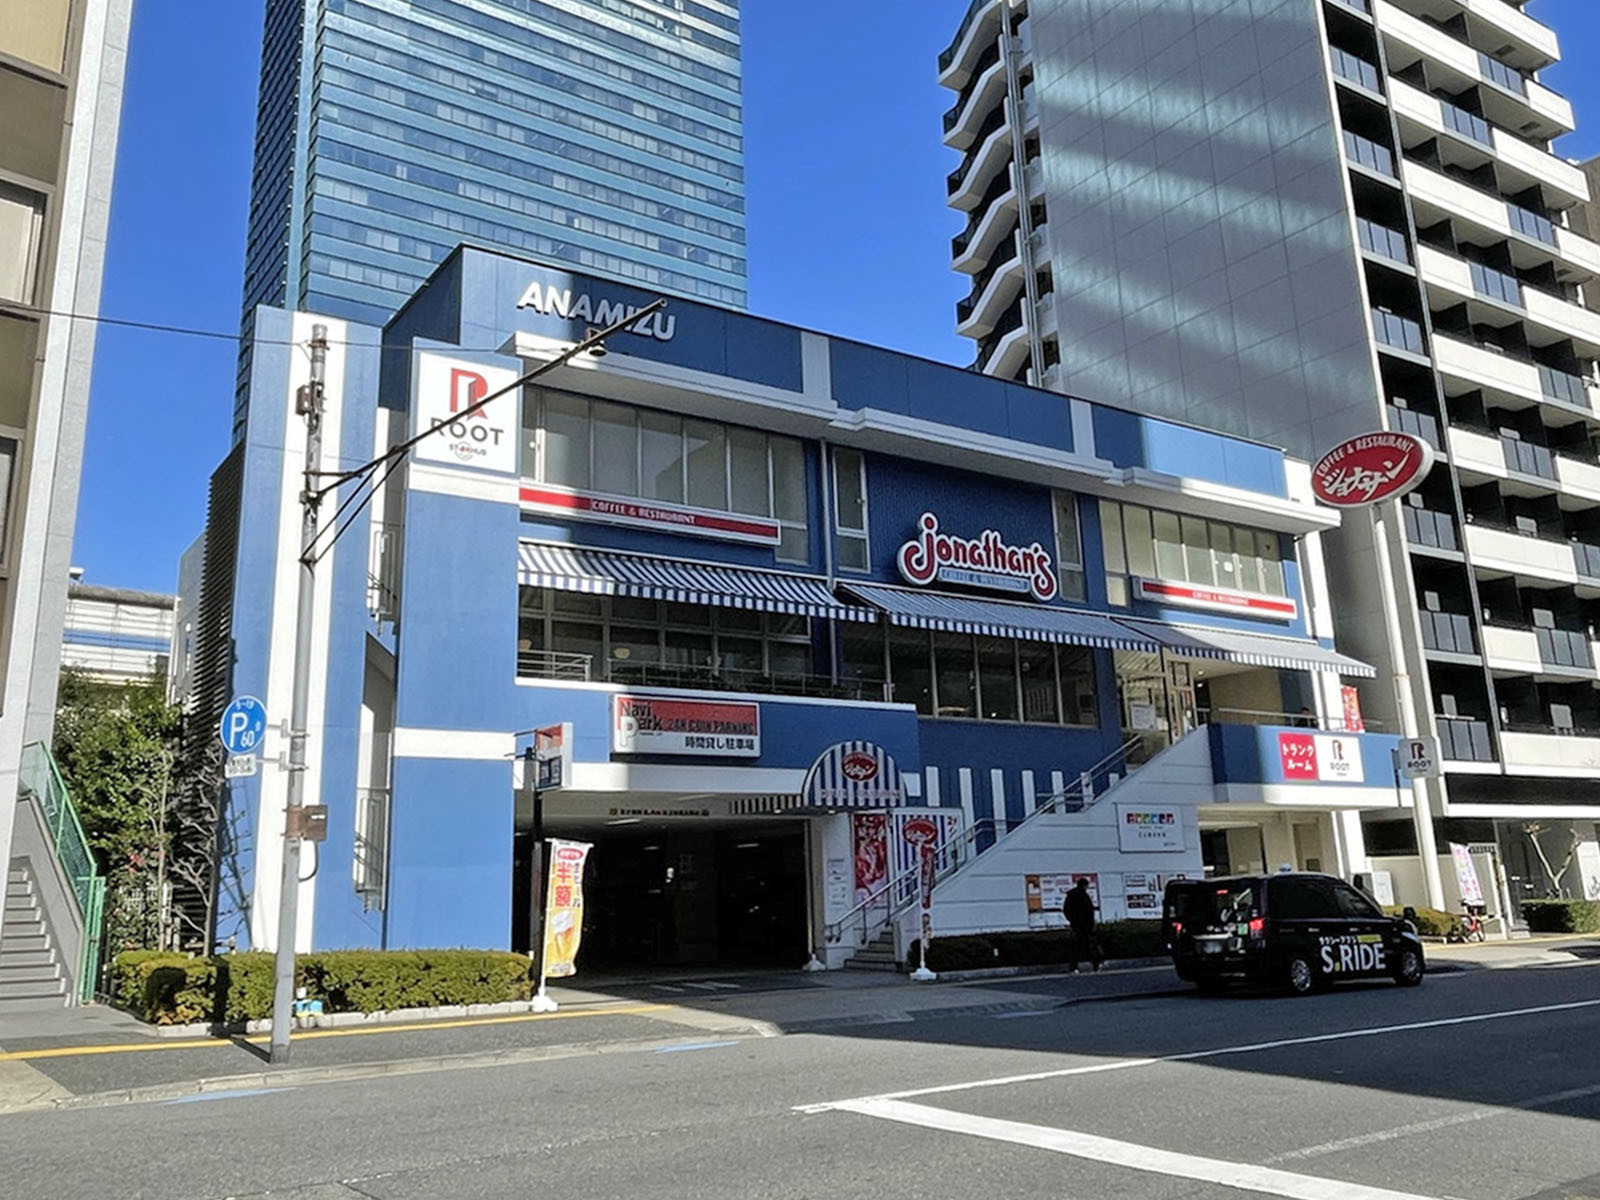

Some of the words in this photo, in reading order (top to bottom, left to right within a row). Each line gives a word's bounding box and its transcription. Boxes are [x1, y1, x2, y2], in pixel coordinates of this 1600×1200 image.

[516, 281, 675, 341] ANAMIZU
[430, 417, 504, 446] ROOT
[1316, 448, 1345, 476] COFFEE
[1355, 435, 1415, 453] RESTAURANT
[621, 701, 651, 717] Navi
[230, 712, 248, 748] P
[240, 730, 255, 747] 60
[620, 713, 662, 747] Park
[685, 735, 755, 751] 時間貸し駐車場
[1282, 743, 1314, 757] トランク
[1287, 759, 1313, 771] ルーム
[1320, 943, 1387, 973] S.RIDE
